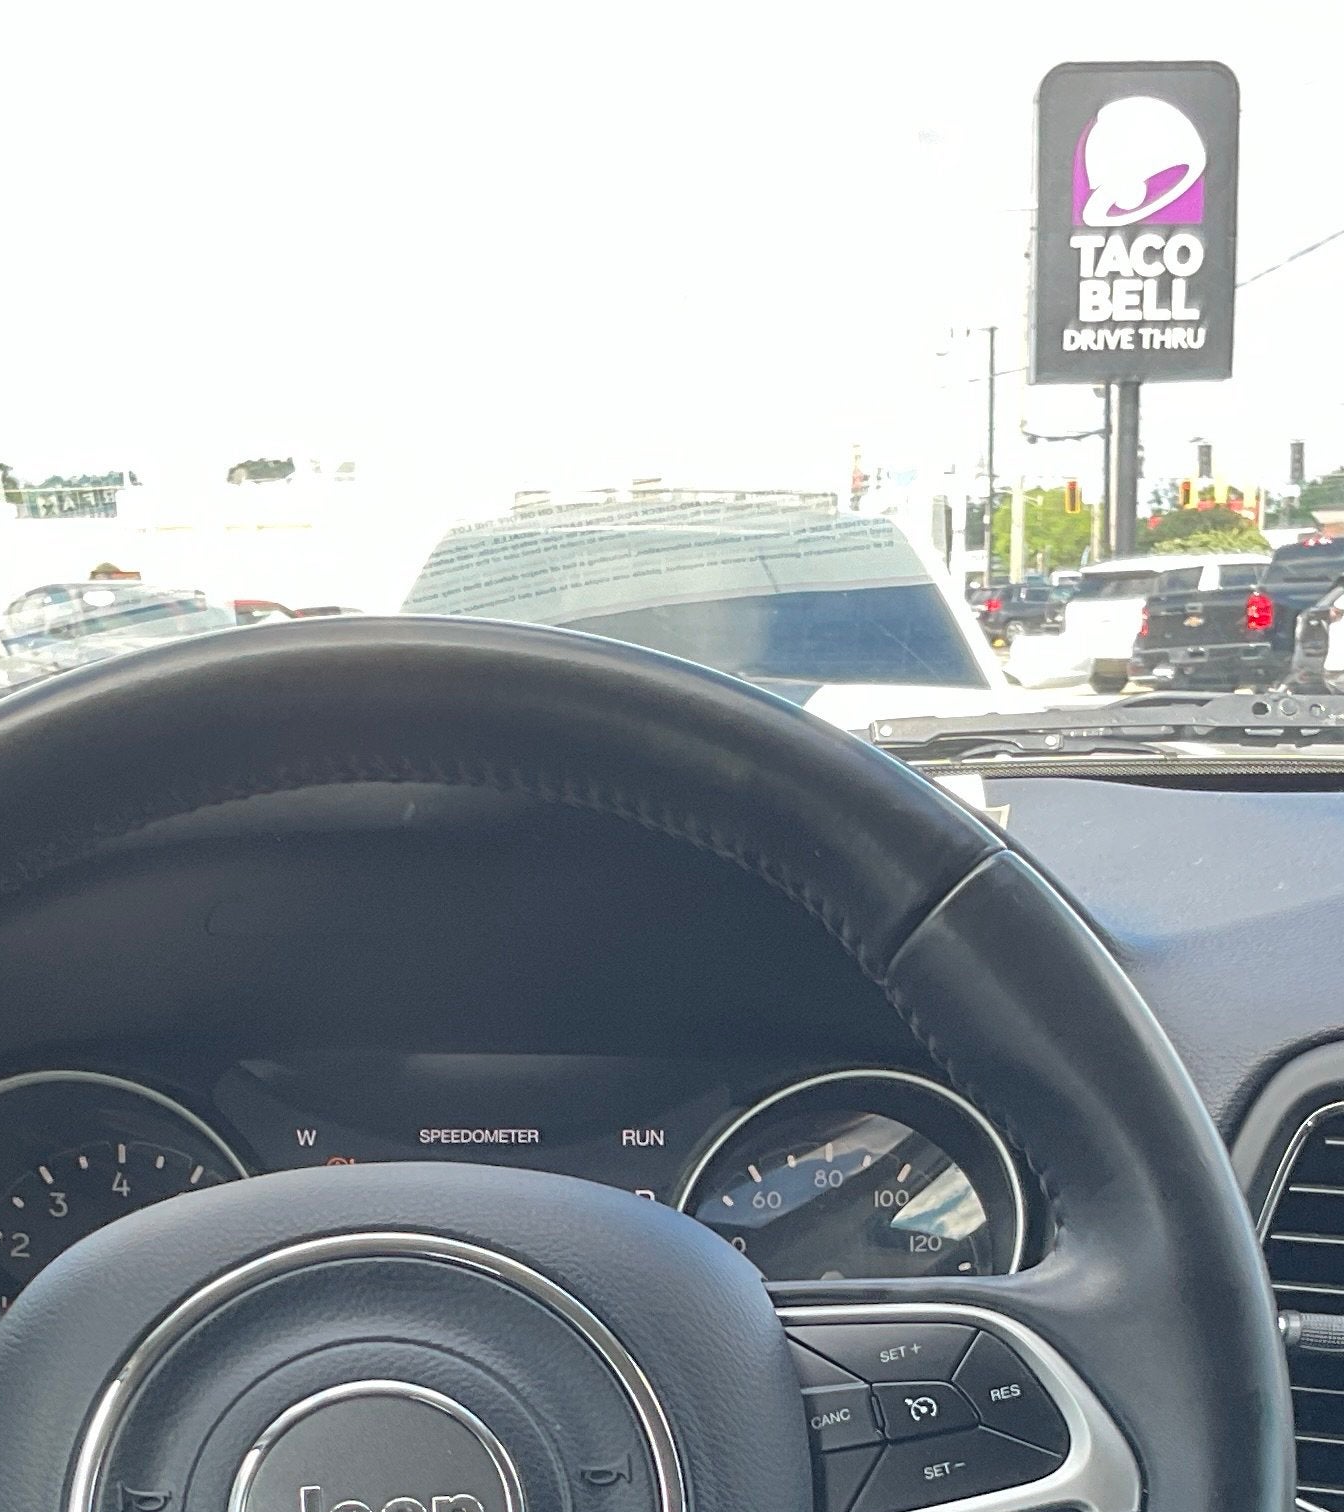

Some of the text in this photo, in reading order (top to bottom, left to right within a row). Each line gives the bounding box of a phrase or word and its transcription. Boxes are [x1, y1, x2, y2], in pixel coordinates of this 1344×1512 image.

[1070, 233, 1204, 278] TACO
[1079, 278, 1200, 322] BELL
[1062, 327, 1205, 352] DRIVE THRU
[296, 1129, 317, 1146] W
[419, 1129, 539, 1144] SPEEDOMETER
[622, 1129, 665, 1146] RUN
[112, 1171, 131, 1197] 4
[814, 1170, 843, 1188] 80
[49, 1192, 68, 1218] 3
[752, 1191, 782, 1209] 60
[874, 1189, 909, 1208] 100
[11, 1232, 31, 1258] 2
[909, 1235, 942, 1253] 120
[879, 1345, 908, 1364] SET
[990, 1384, 1021, 1402] RES
[810, 1409, 851, 1430] CANC
[924, 1462, 951, 1480] SET
